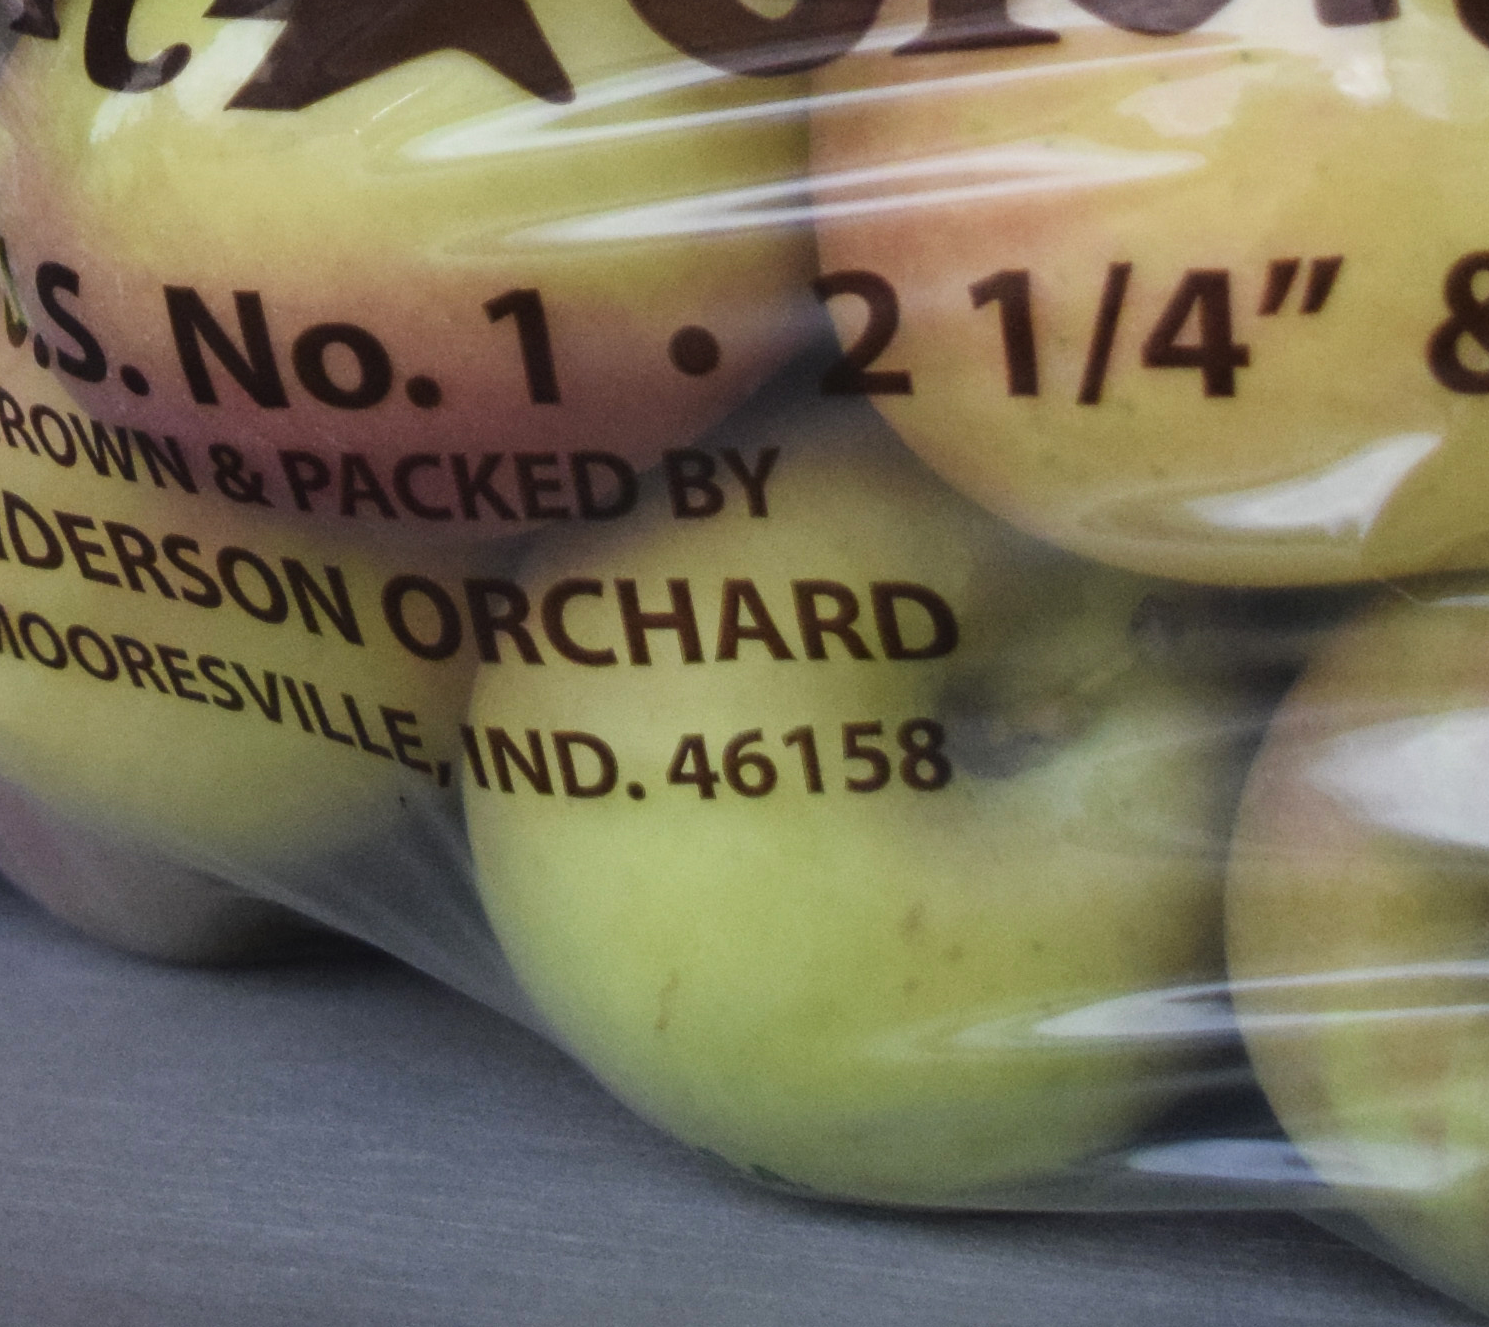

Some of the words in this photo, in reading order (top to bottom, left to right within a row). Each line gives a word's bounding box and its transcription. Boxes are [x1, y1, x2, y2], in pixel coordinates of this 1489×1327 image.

[164, 285, 443, 411] No.
[485, 289, 562, 405] 1
[811, 271, 914, 398] 2
[207, 443, 267, 509] &
[293, 448, 639, 524] PACKED
[665, 445, 782, 519] BY
[382, 577, 961, 668] ORCHARD
[463, 723, 648, 803] IND.
[668, 716, 954, 803] 46158
